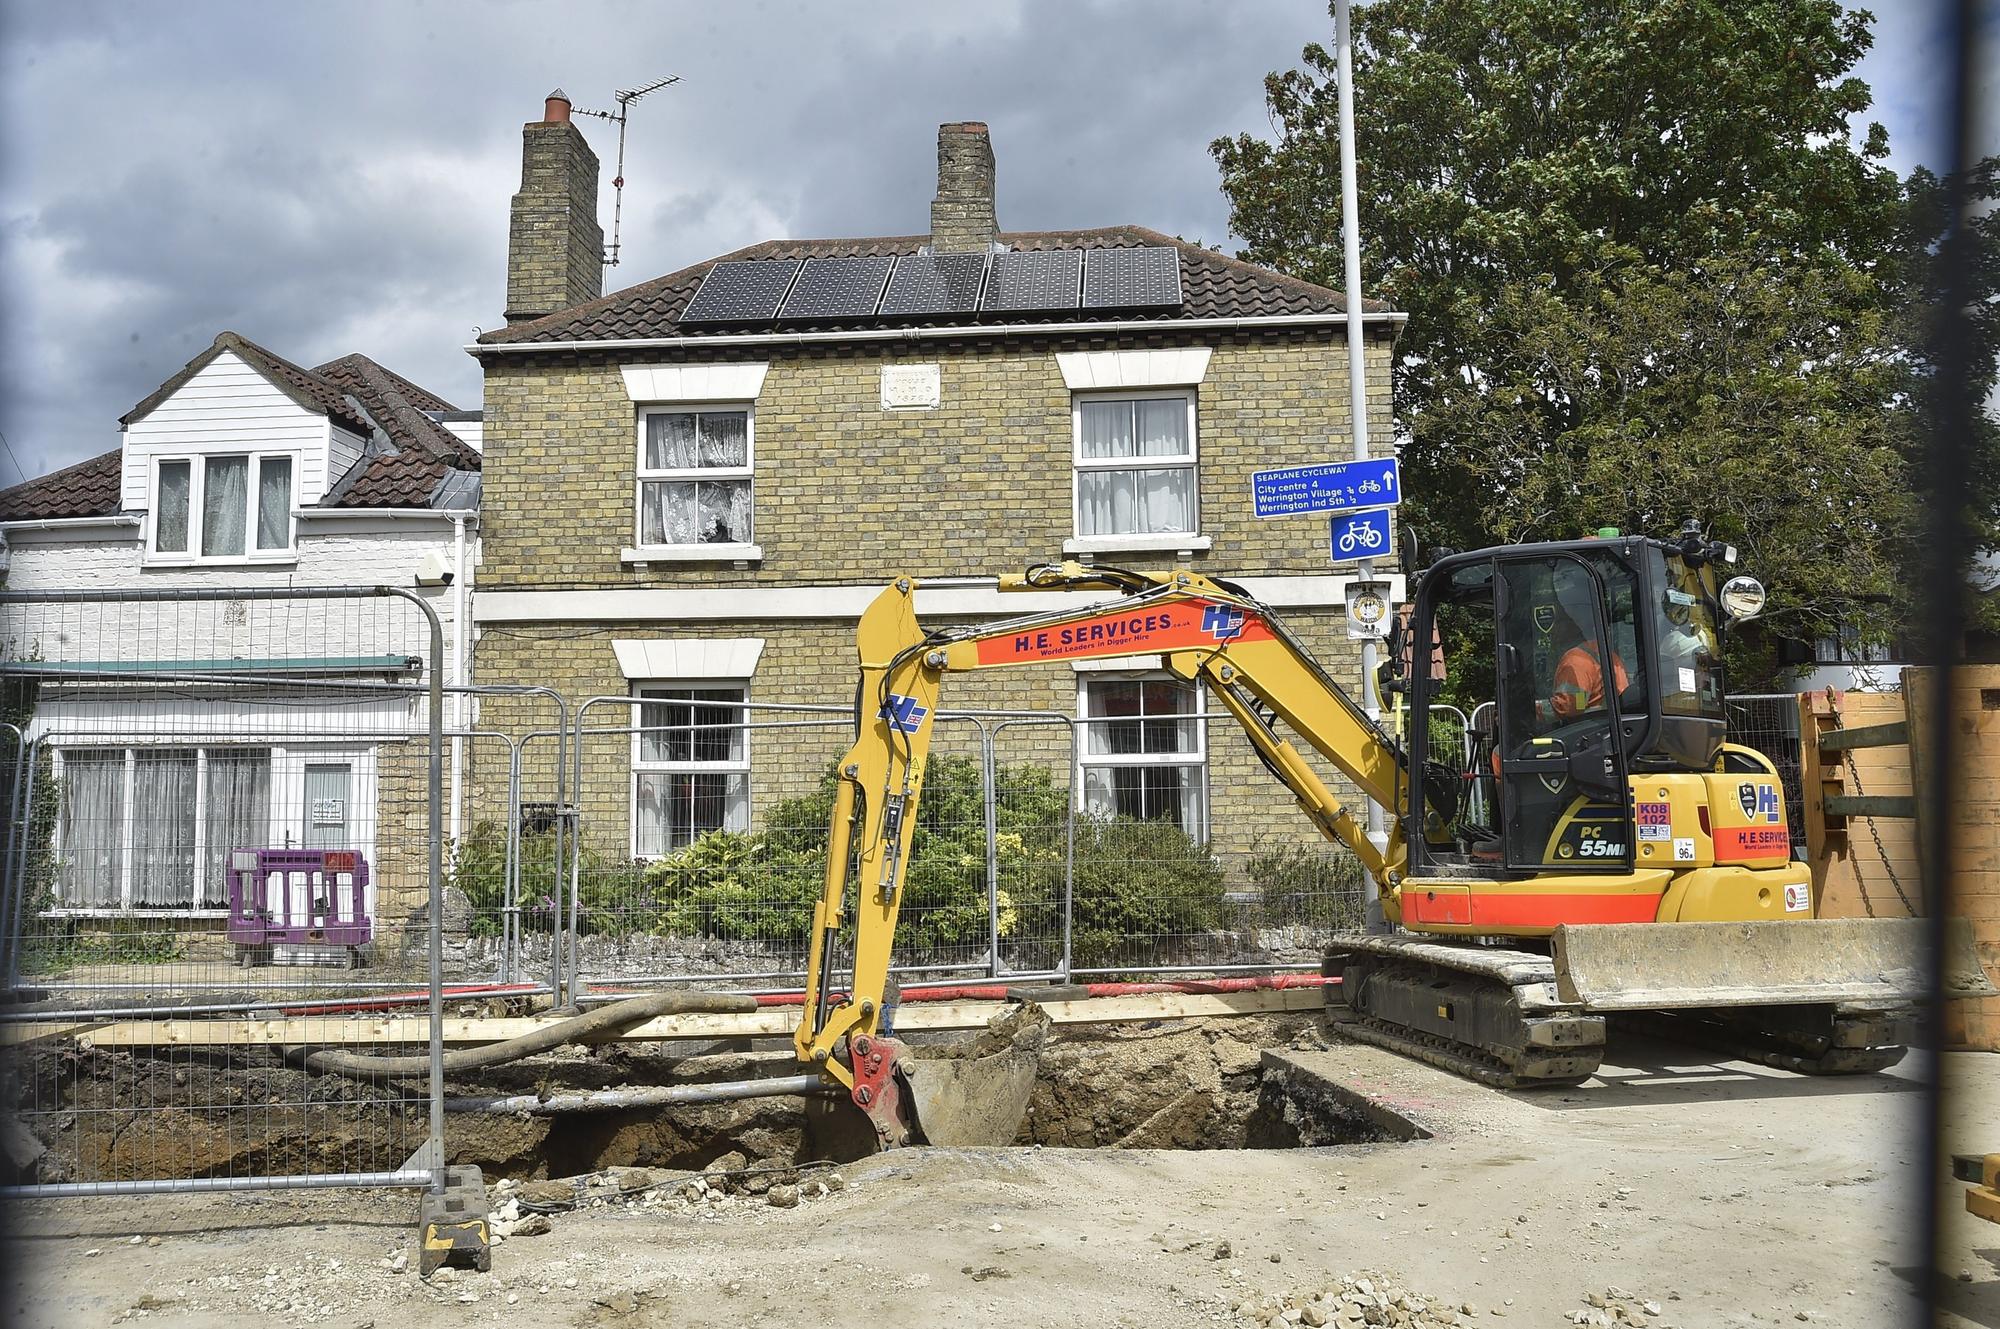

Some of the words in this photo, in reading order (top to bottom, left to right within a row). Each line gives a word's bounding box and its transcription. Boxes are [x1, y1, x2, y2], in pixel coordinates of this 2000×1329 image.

[1256, 471, 1300, 482] SEAPLANE
[1302, 466, 1347, 477] CYCLEWAY
[1258, 486, 1276, 494] City
[1279, 482, 1307, 491] centre
[1311, 480, 1319, 488] 4
[1258, 492, 1308, 503] Werrington
[1310, 489, 1342, 498] Village
[1259, 502, 1309, 512] Werrington
[1311, 499, 1326, 507] Ind
[1328, 497, 1345, 506] Sth
[1040, 647, 1063, 657] World
[1064, 643, 1095, 652] Leaders
[1107, 637, 1131, 646] Digger
[1640, 804, 1667, 814] K08
[1641, 814, 1667, 825] 102
[1580, 826, 1602, 839] PC
